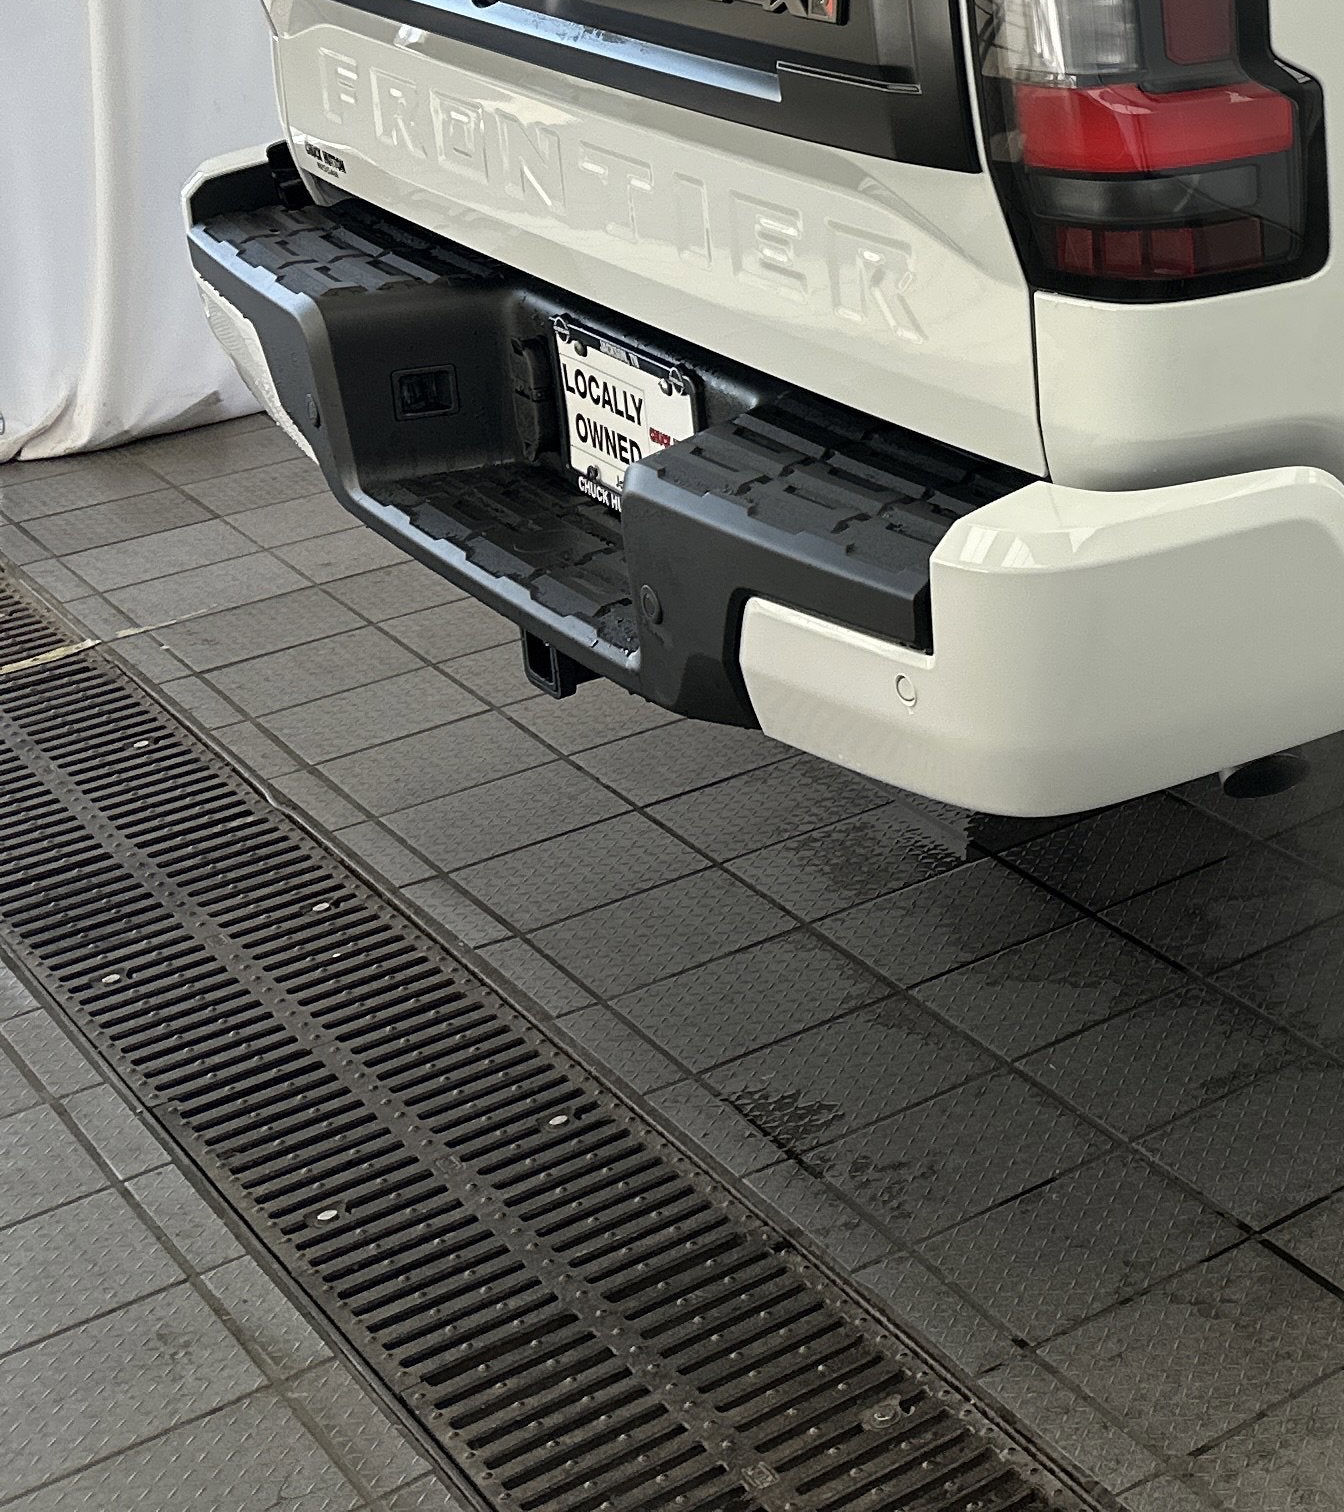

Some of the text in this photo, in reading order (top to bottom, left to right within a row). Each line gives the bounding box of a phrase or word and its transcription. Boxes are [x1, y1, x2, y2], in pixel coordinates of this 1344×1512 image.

[318, 47, 928, 345] FRONTIER
[562, 363, 643, 426] LOCALLY
[575, 413, 642, 465] OWNED
[578, 476, 609, 506] CHUCK
